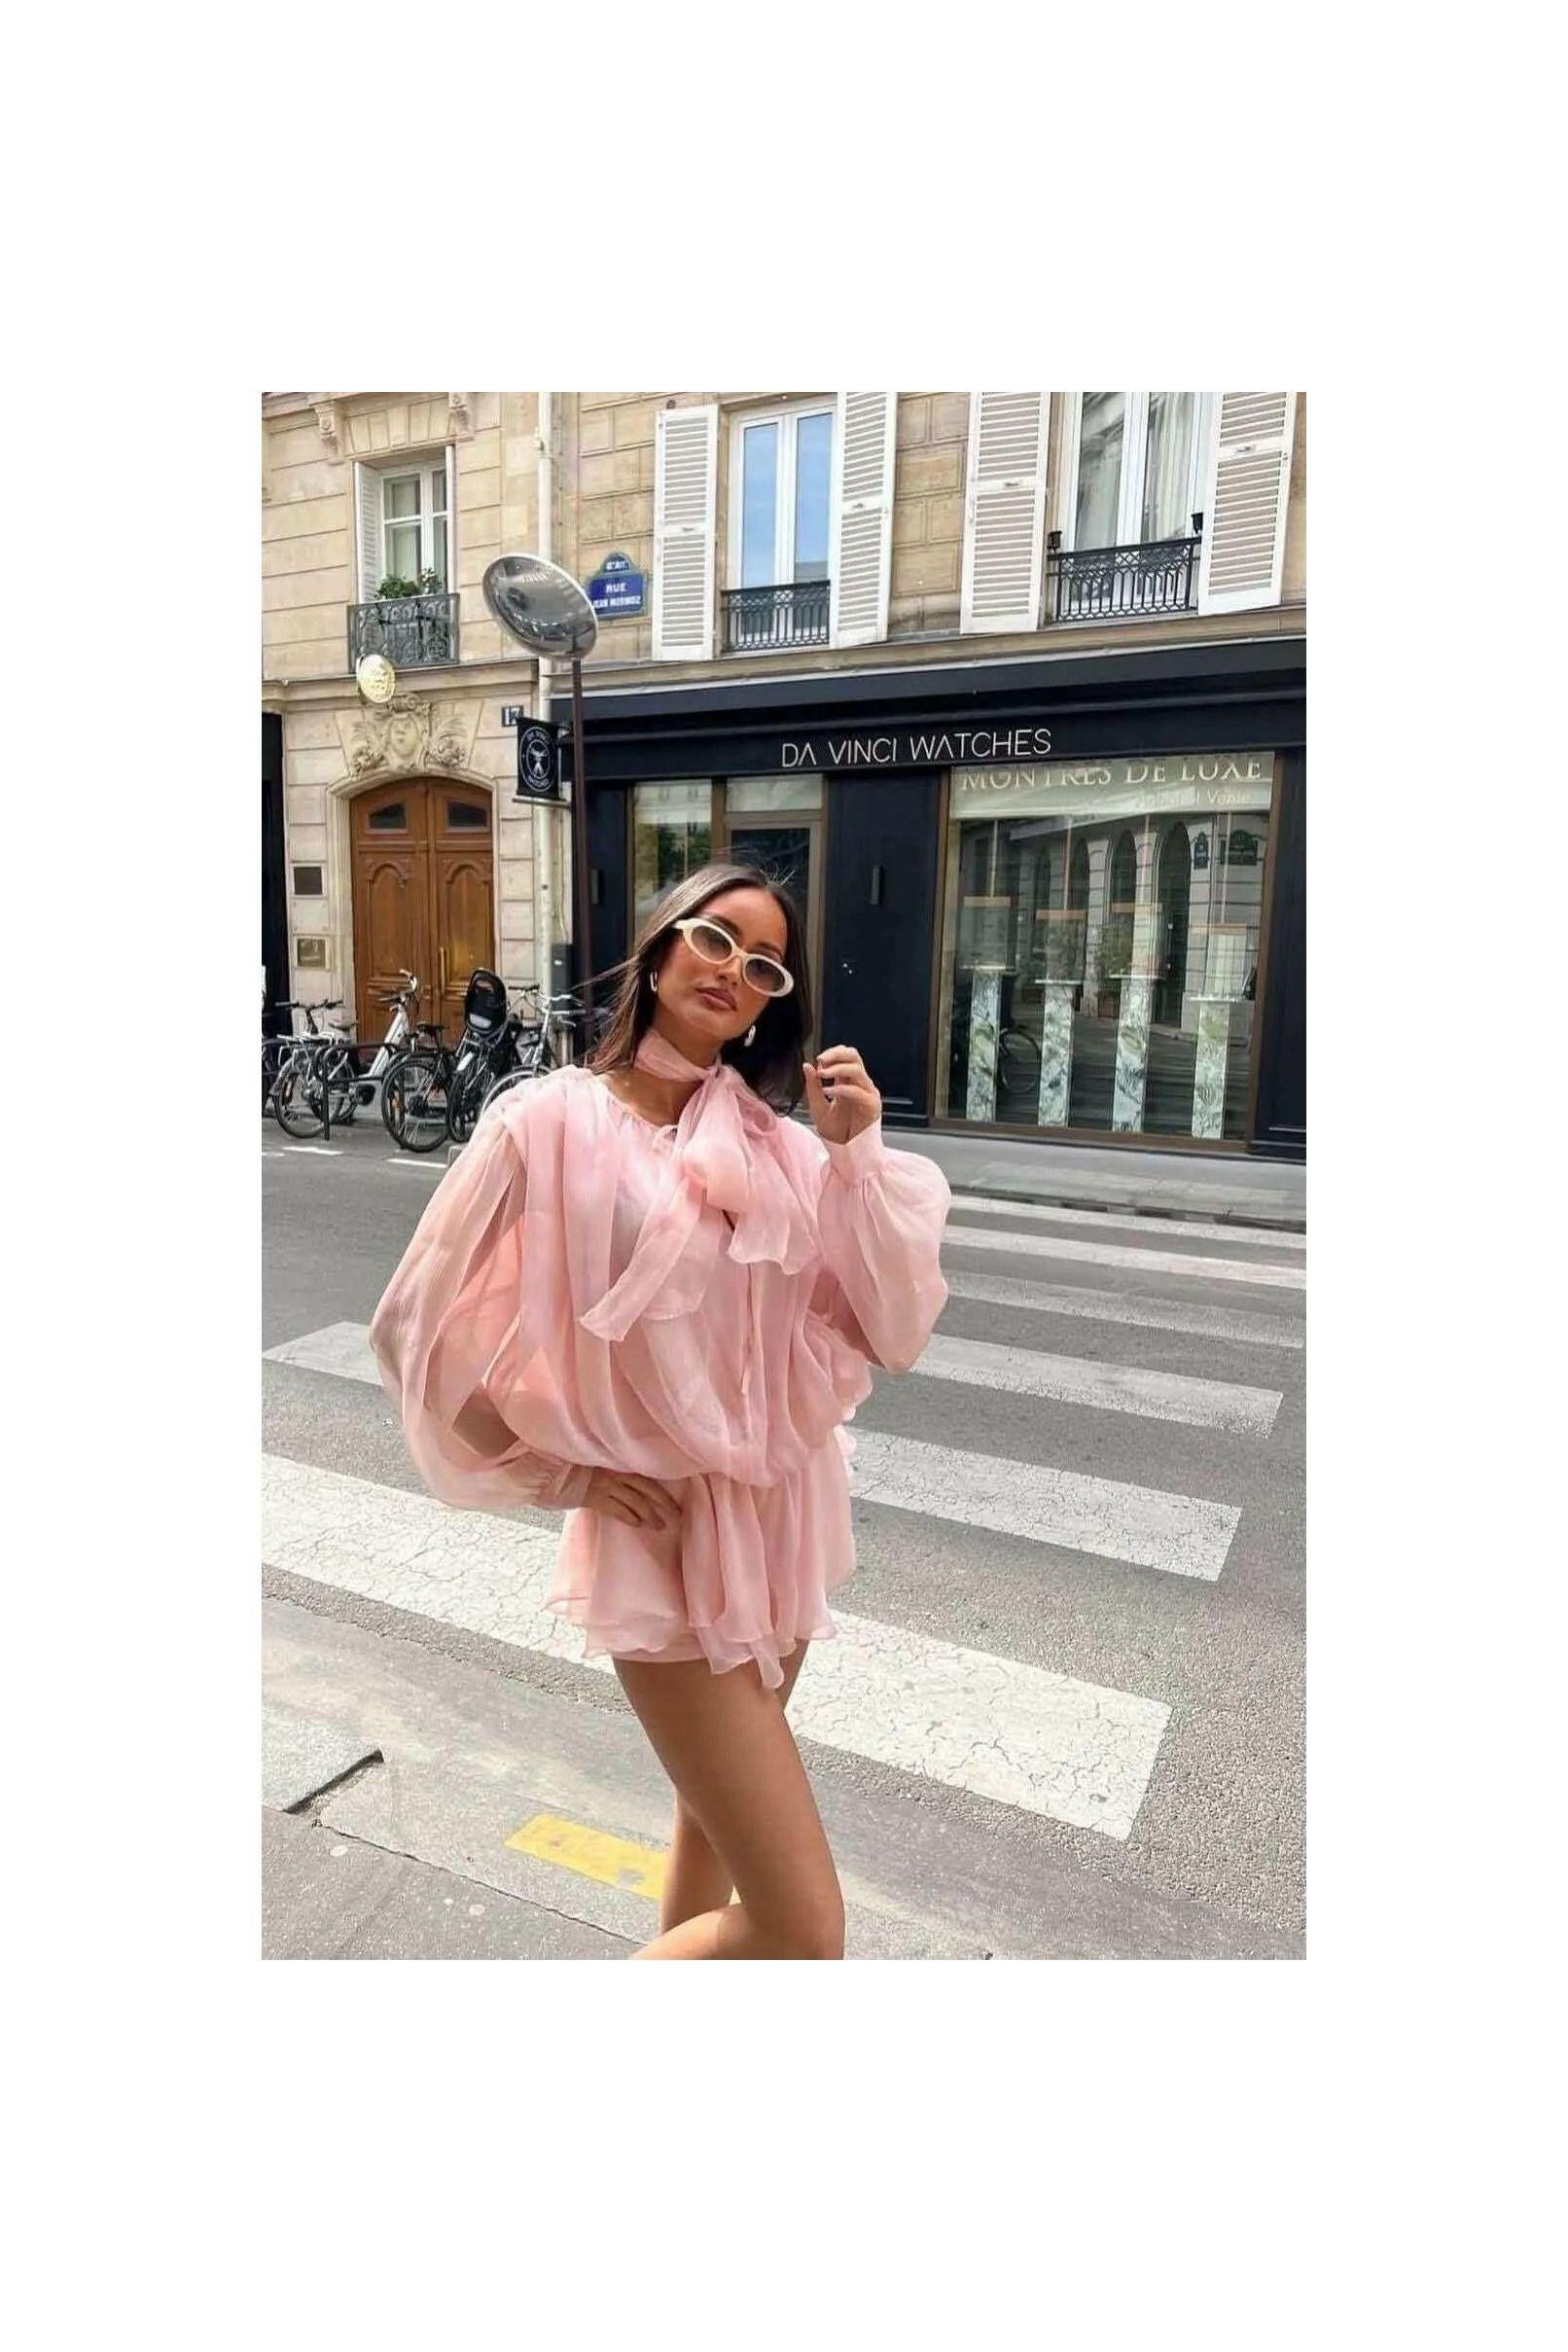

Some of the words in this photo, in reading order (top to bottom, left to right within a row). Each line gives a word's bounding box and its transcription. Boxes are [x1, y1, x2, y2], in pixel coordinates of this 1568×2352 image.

[606, 583, 627, 593] RUE
[505, 707, 520, 725] 17
[782, 742, 816, 767] DA
[829, 737, 897, 765] VINCI
[909, 729, 1051, 761] WATCHES
[1125, 764, 1166, 783] DE
[1181, 760, 1262, 781] LUXE
